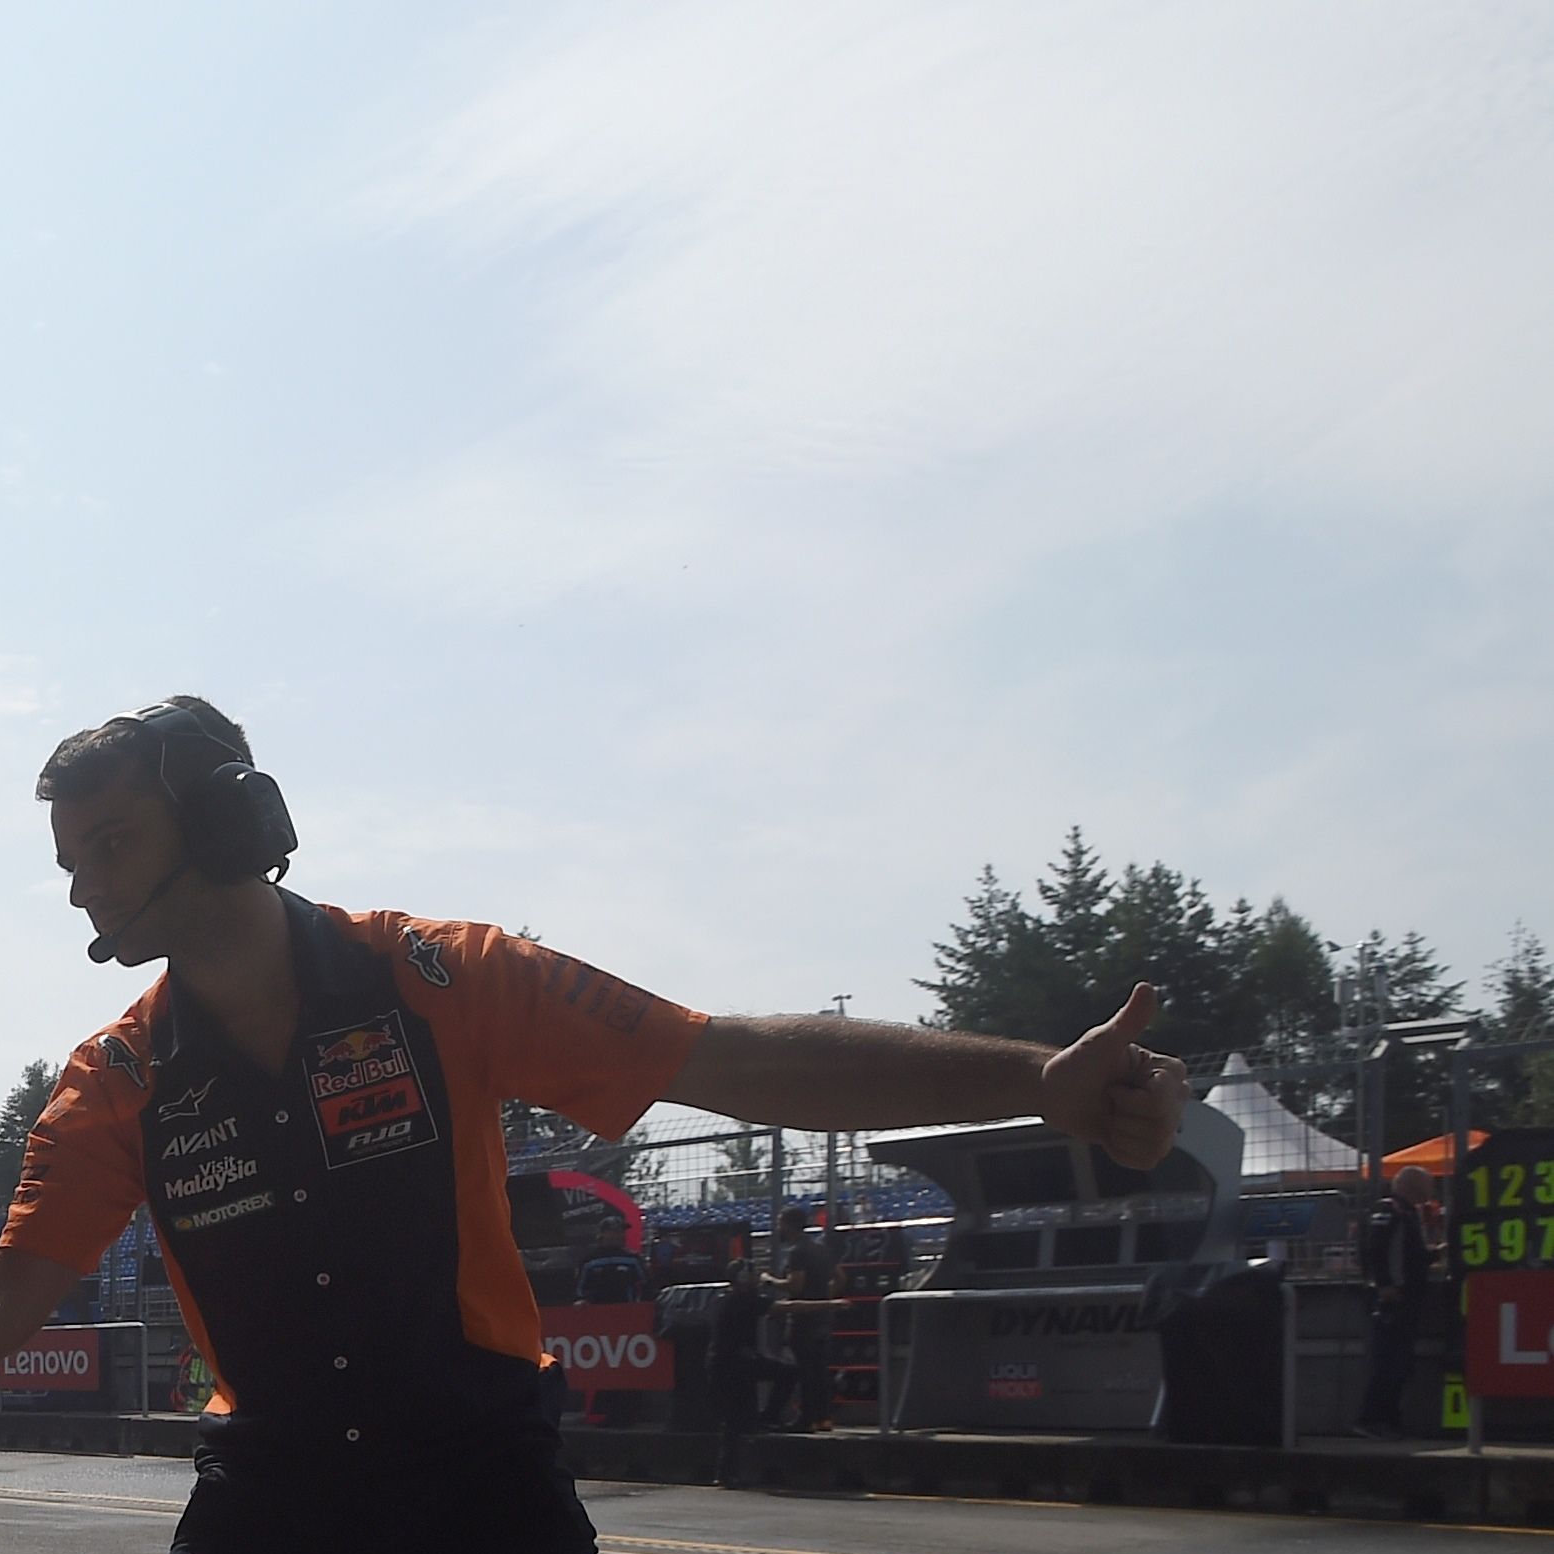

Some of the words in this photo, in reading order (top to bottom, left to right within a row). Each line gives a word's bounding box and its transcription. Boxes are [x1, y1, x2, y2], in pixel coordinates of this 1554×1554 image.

[311, 1062, 364, 1098] Red
[363, 1048, 410, 1083] Bull
[339, 1090, 408, 1126] KTM
[161, 1117, 239, 1160] AVANT
[348, 1121, 411, 1149] AJO
[165, 1160, 257, 1200] Malaysia
[199, 1156, 236, 1176] Visit
[193, 1193, 273, 1228] MOTOREX
[4, 1347, 90, 1377] Lenovo
[545, 1323, 658, 1370] novo
